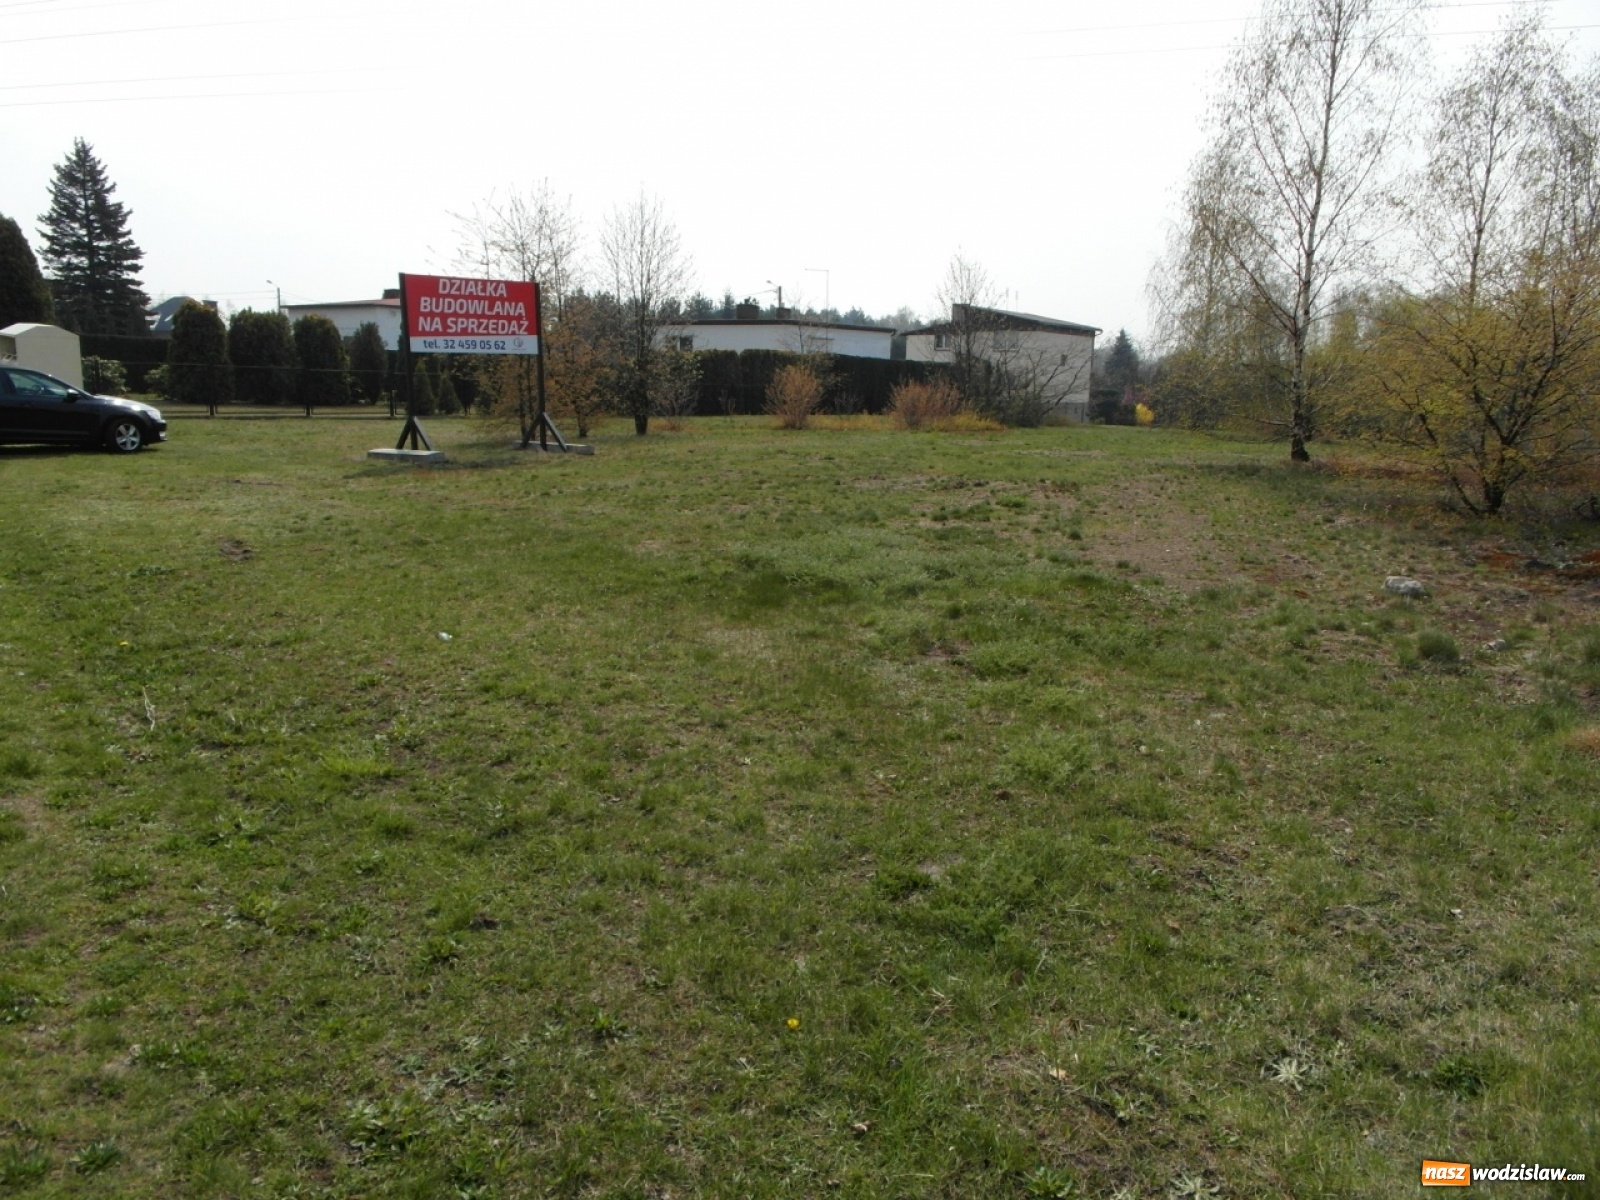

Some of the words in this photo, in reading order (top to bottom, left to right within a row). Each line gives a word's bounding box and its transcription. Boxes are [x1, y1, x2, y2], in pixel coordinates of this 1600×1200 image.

[438, 278, 507, 297] DZIAŁKA
[420, 297, 526, 316] BUDOWLANA
[418, 316, 443, 332] NA
[446, 317, 529, 335] SPRZEDAŻ
[423, 339, 440, 349] tel.
[443, 339, 456, 349] 32
[458, 340, 477, 350] 459
[480, 340, 492, 350] 05
[494, 340, 506, 350] 62
